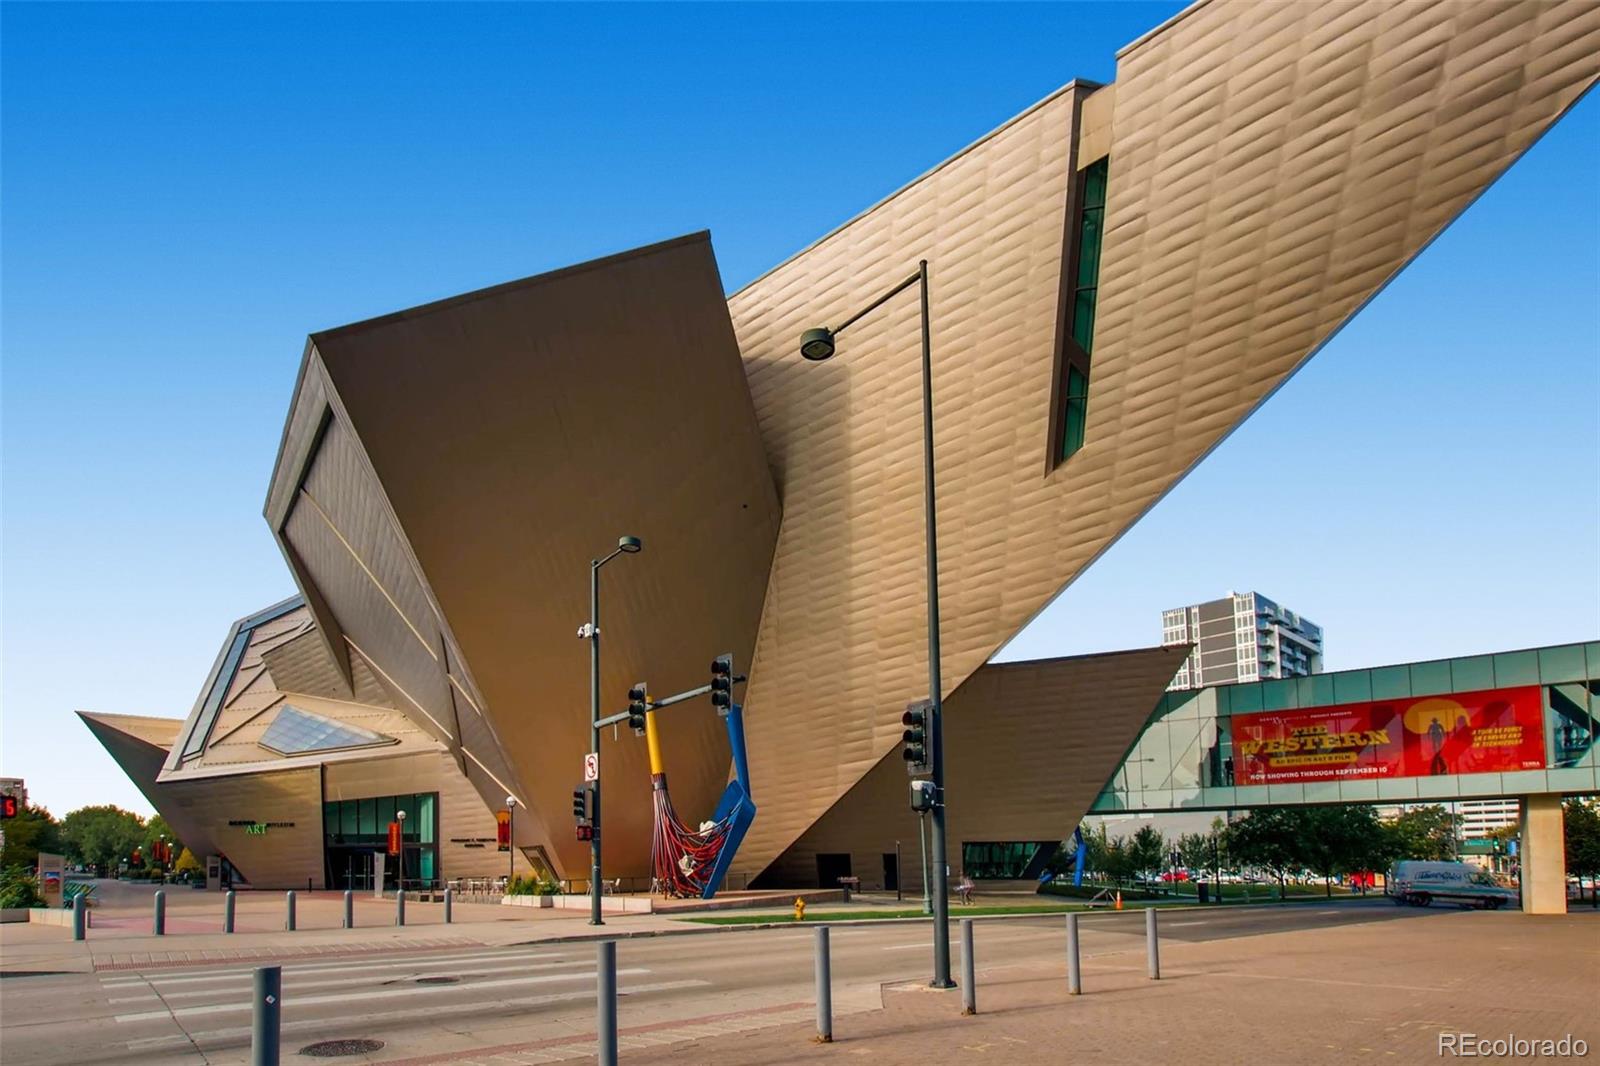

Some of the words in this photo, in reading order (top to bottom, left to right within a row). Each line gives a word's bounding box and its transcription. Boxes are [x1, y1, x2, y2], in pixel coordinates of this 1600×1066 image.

[1292, 725, 1328, 735] THE
[1241, 730, 1390, 754] WESTERN
[1335, 767, 1378, 775] SEPTEMBER
[246, 823, 267, 834] ART
